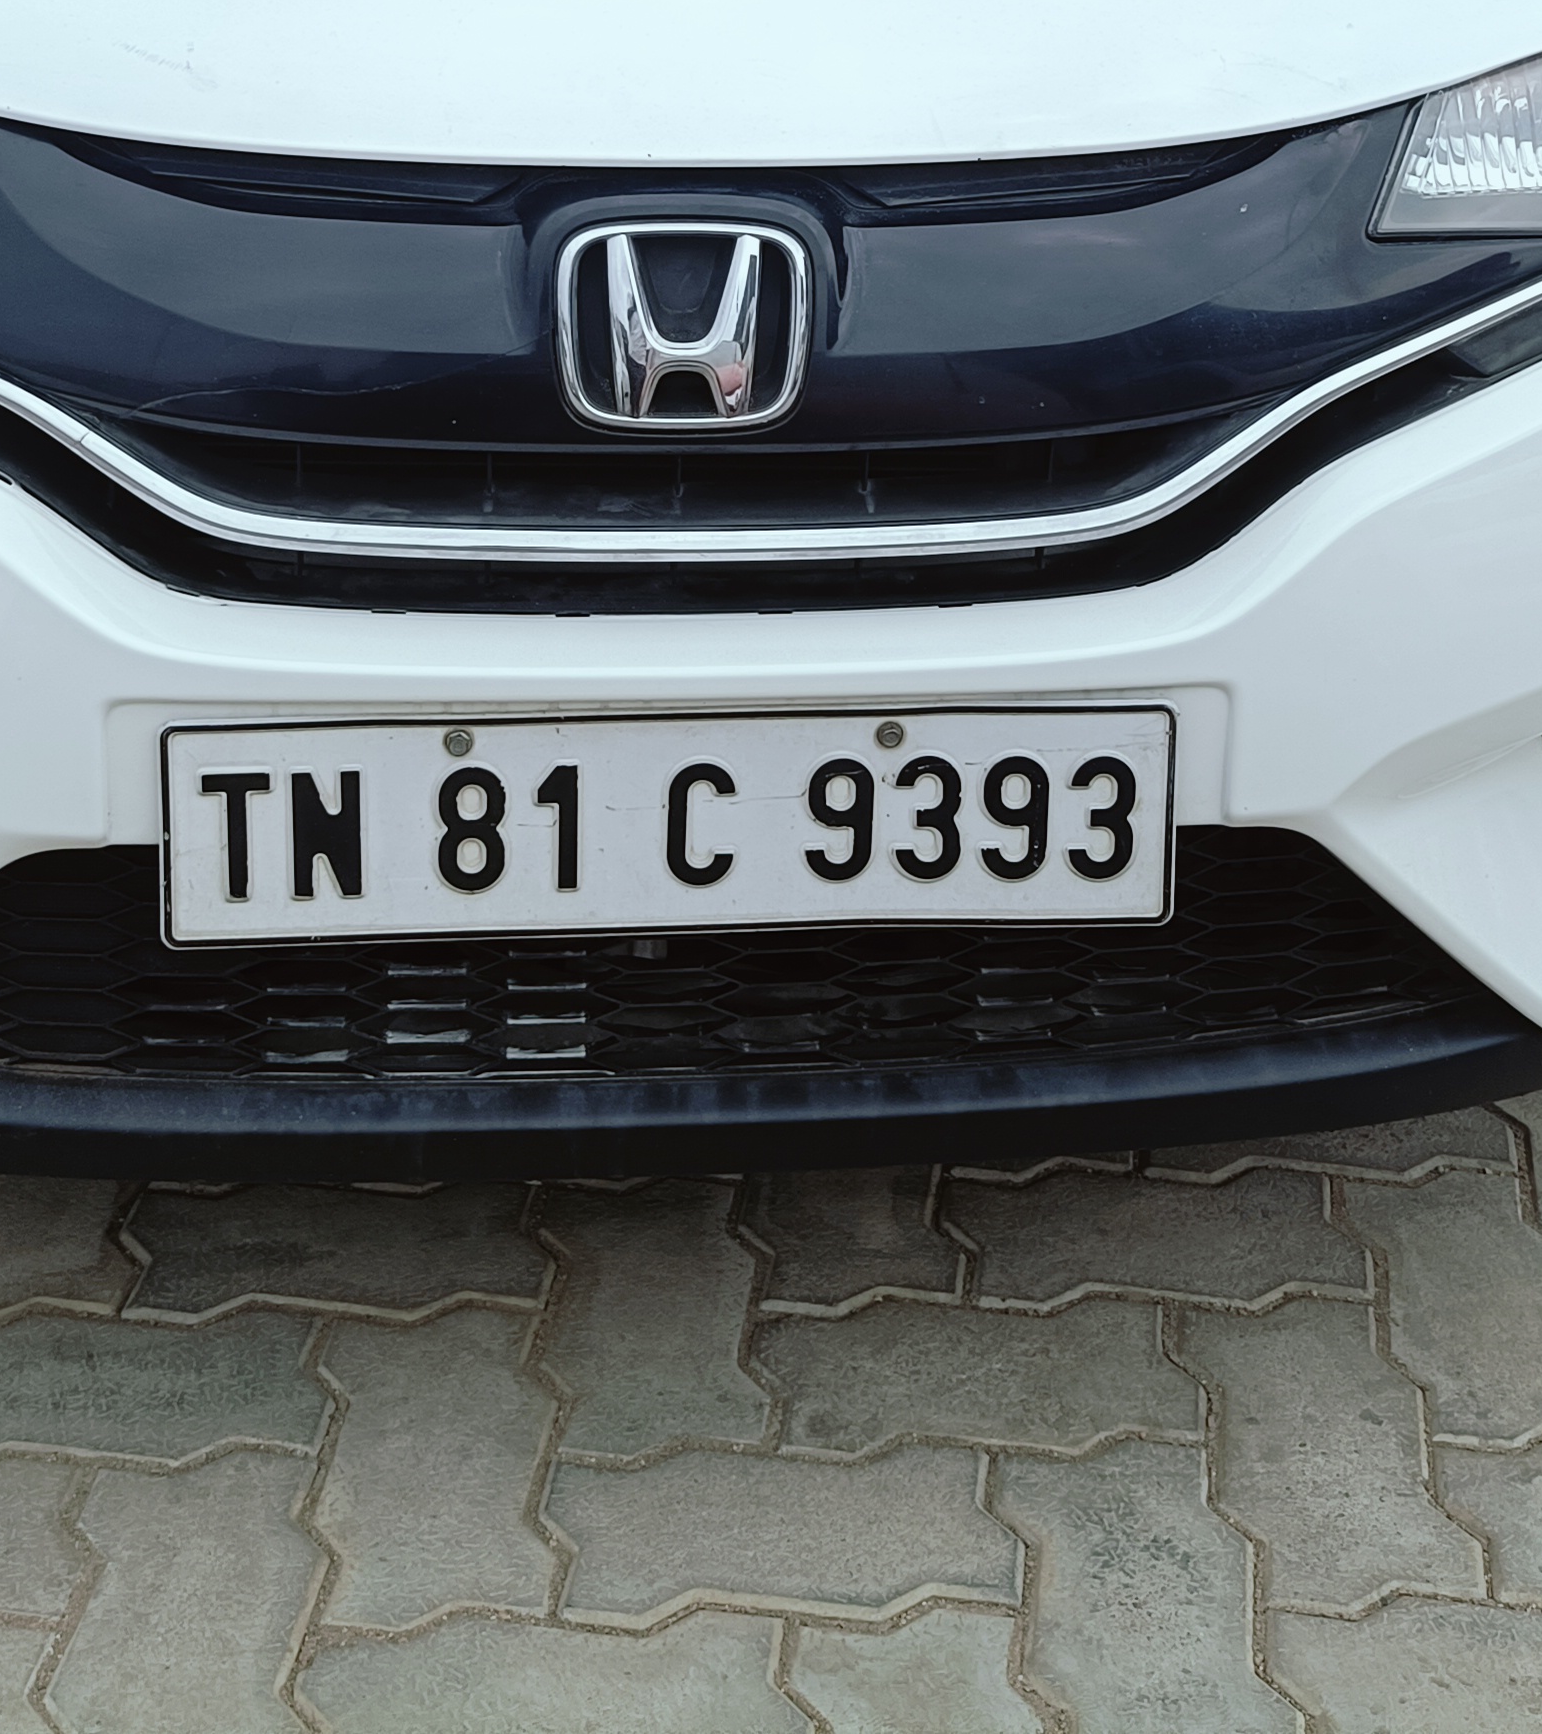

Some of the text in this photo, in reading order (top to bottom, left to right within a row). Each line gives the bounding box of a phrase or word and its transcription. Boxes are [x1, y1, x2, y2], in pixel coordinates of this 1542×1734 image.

[200, 754, 1138, 900] TN 81 C 9393
